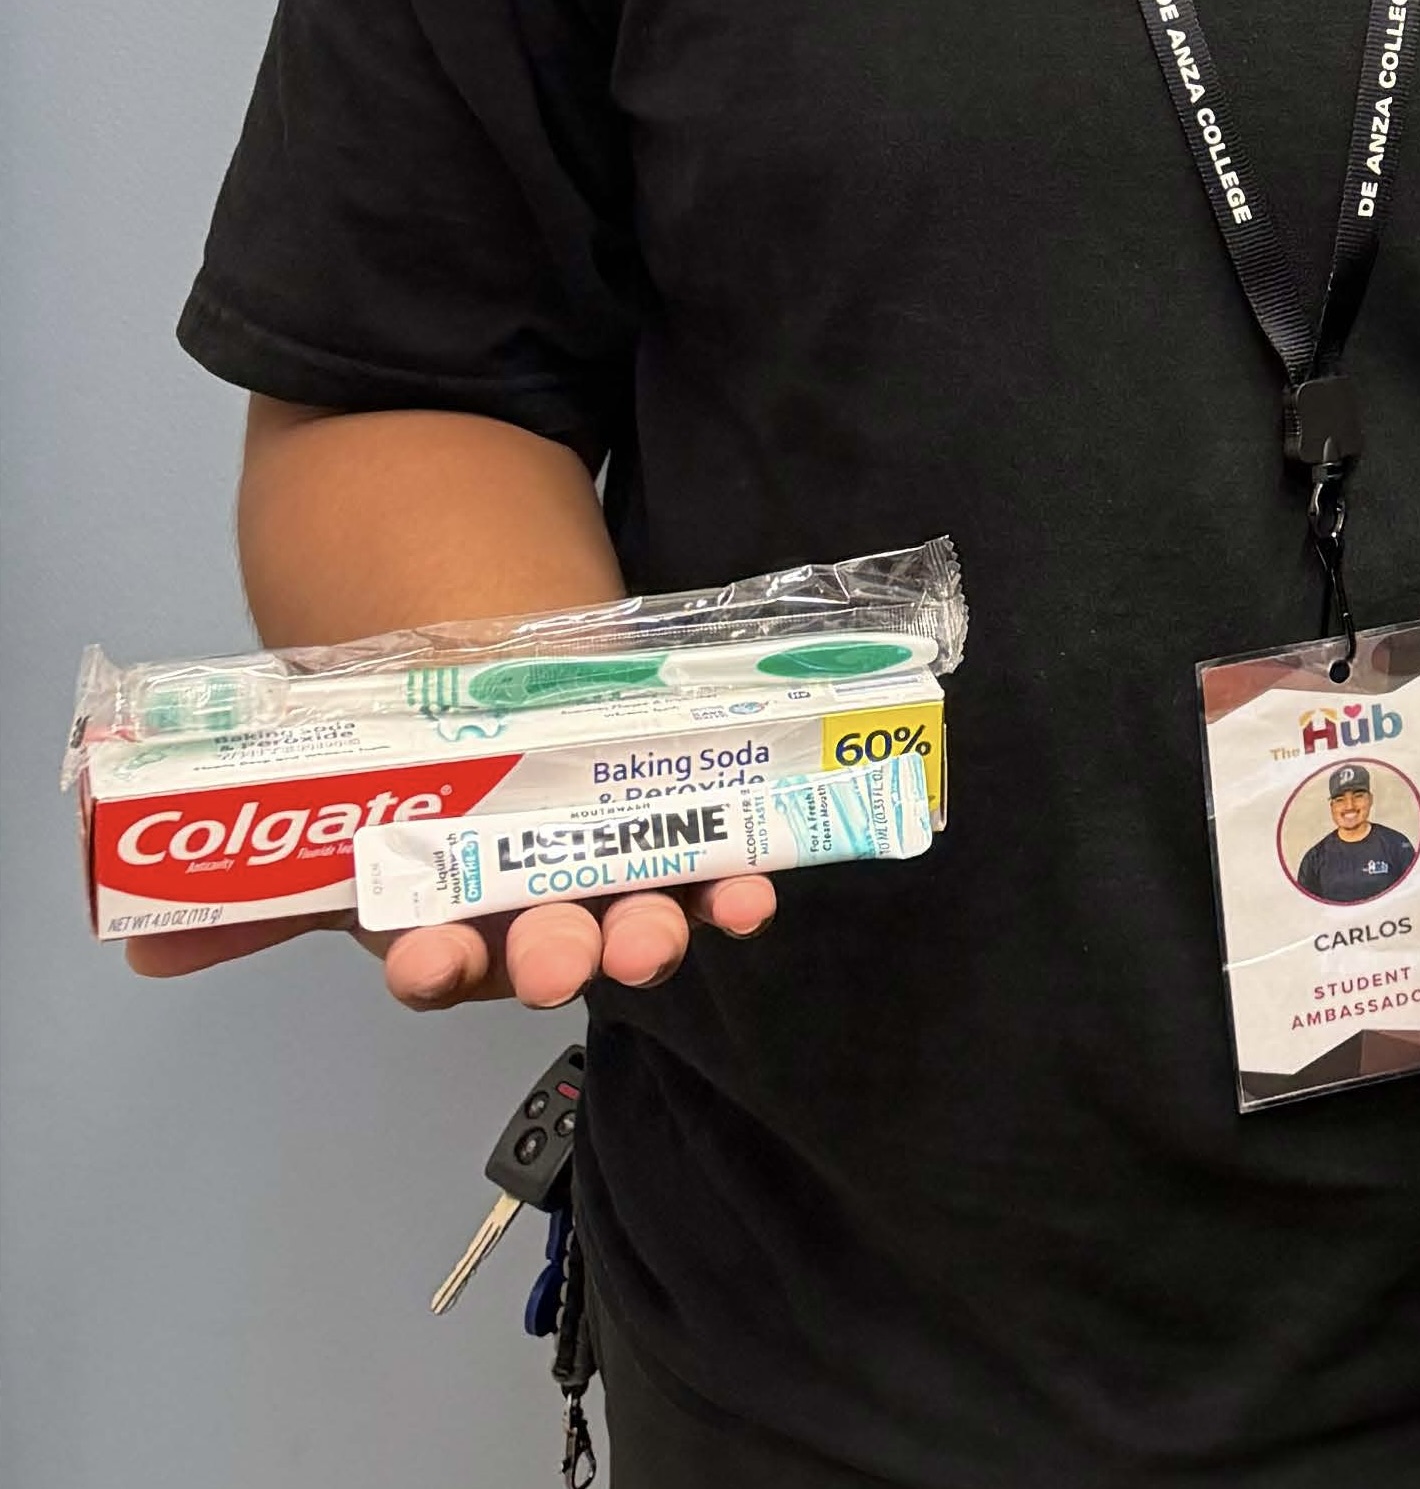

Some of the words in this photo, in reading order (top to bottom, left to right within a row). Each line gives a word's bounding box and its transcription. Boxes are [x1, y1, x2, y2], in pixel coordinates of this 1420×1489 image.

[1167, 29, 1206, 104] ANZA
[1197, 108, 1253, 224] COLLEGE
[1366, 97, 1393, 175] ANZA
[1358, 182, 1378, 217] DE
[835, 724, 932, 767] 60%
[1270, 746, 1299, 761] The
[1303, 703, 1403, 755] Hub
[593, 752, 692, 784] Baking
[699, 740, 770, 771] Soda
[116, 790, 442, 866] Colgate
[497, 803, 729, 872] LISTERINE
[528, 863, 616, 896] COOL
[625, 850, 701, 882] MINT
[1314, 917, 1413, 952] CARLOS
[1314, 967, 1411, 1000] STUDENT
